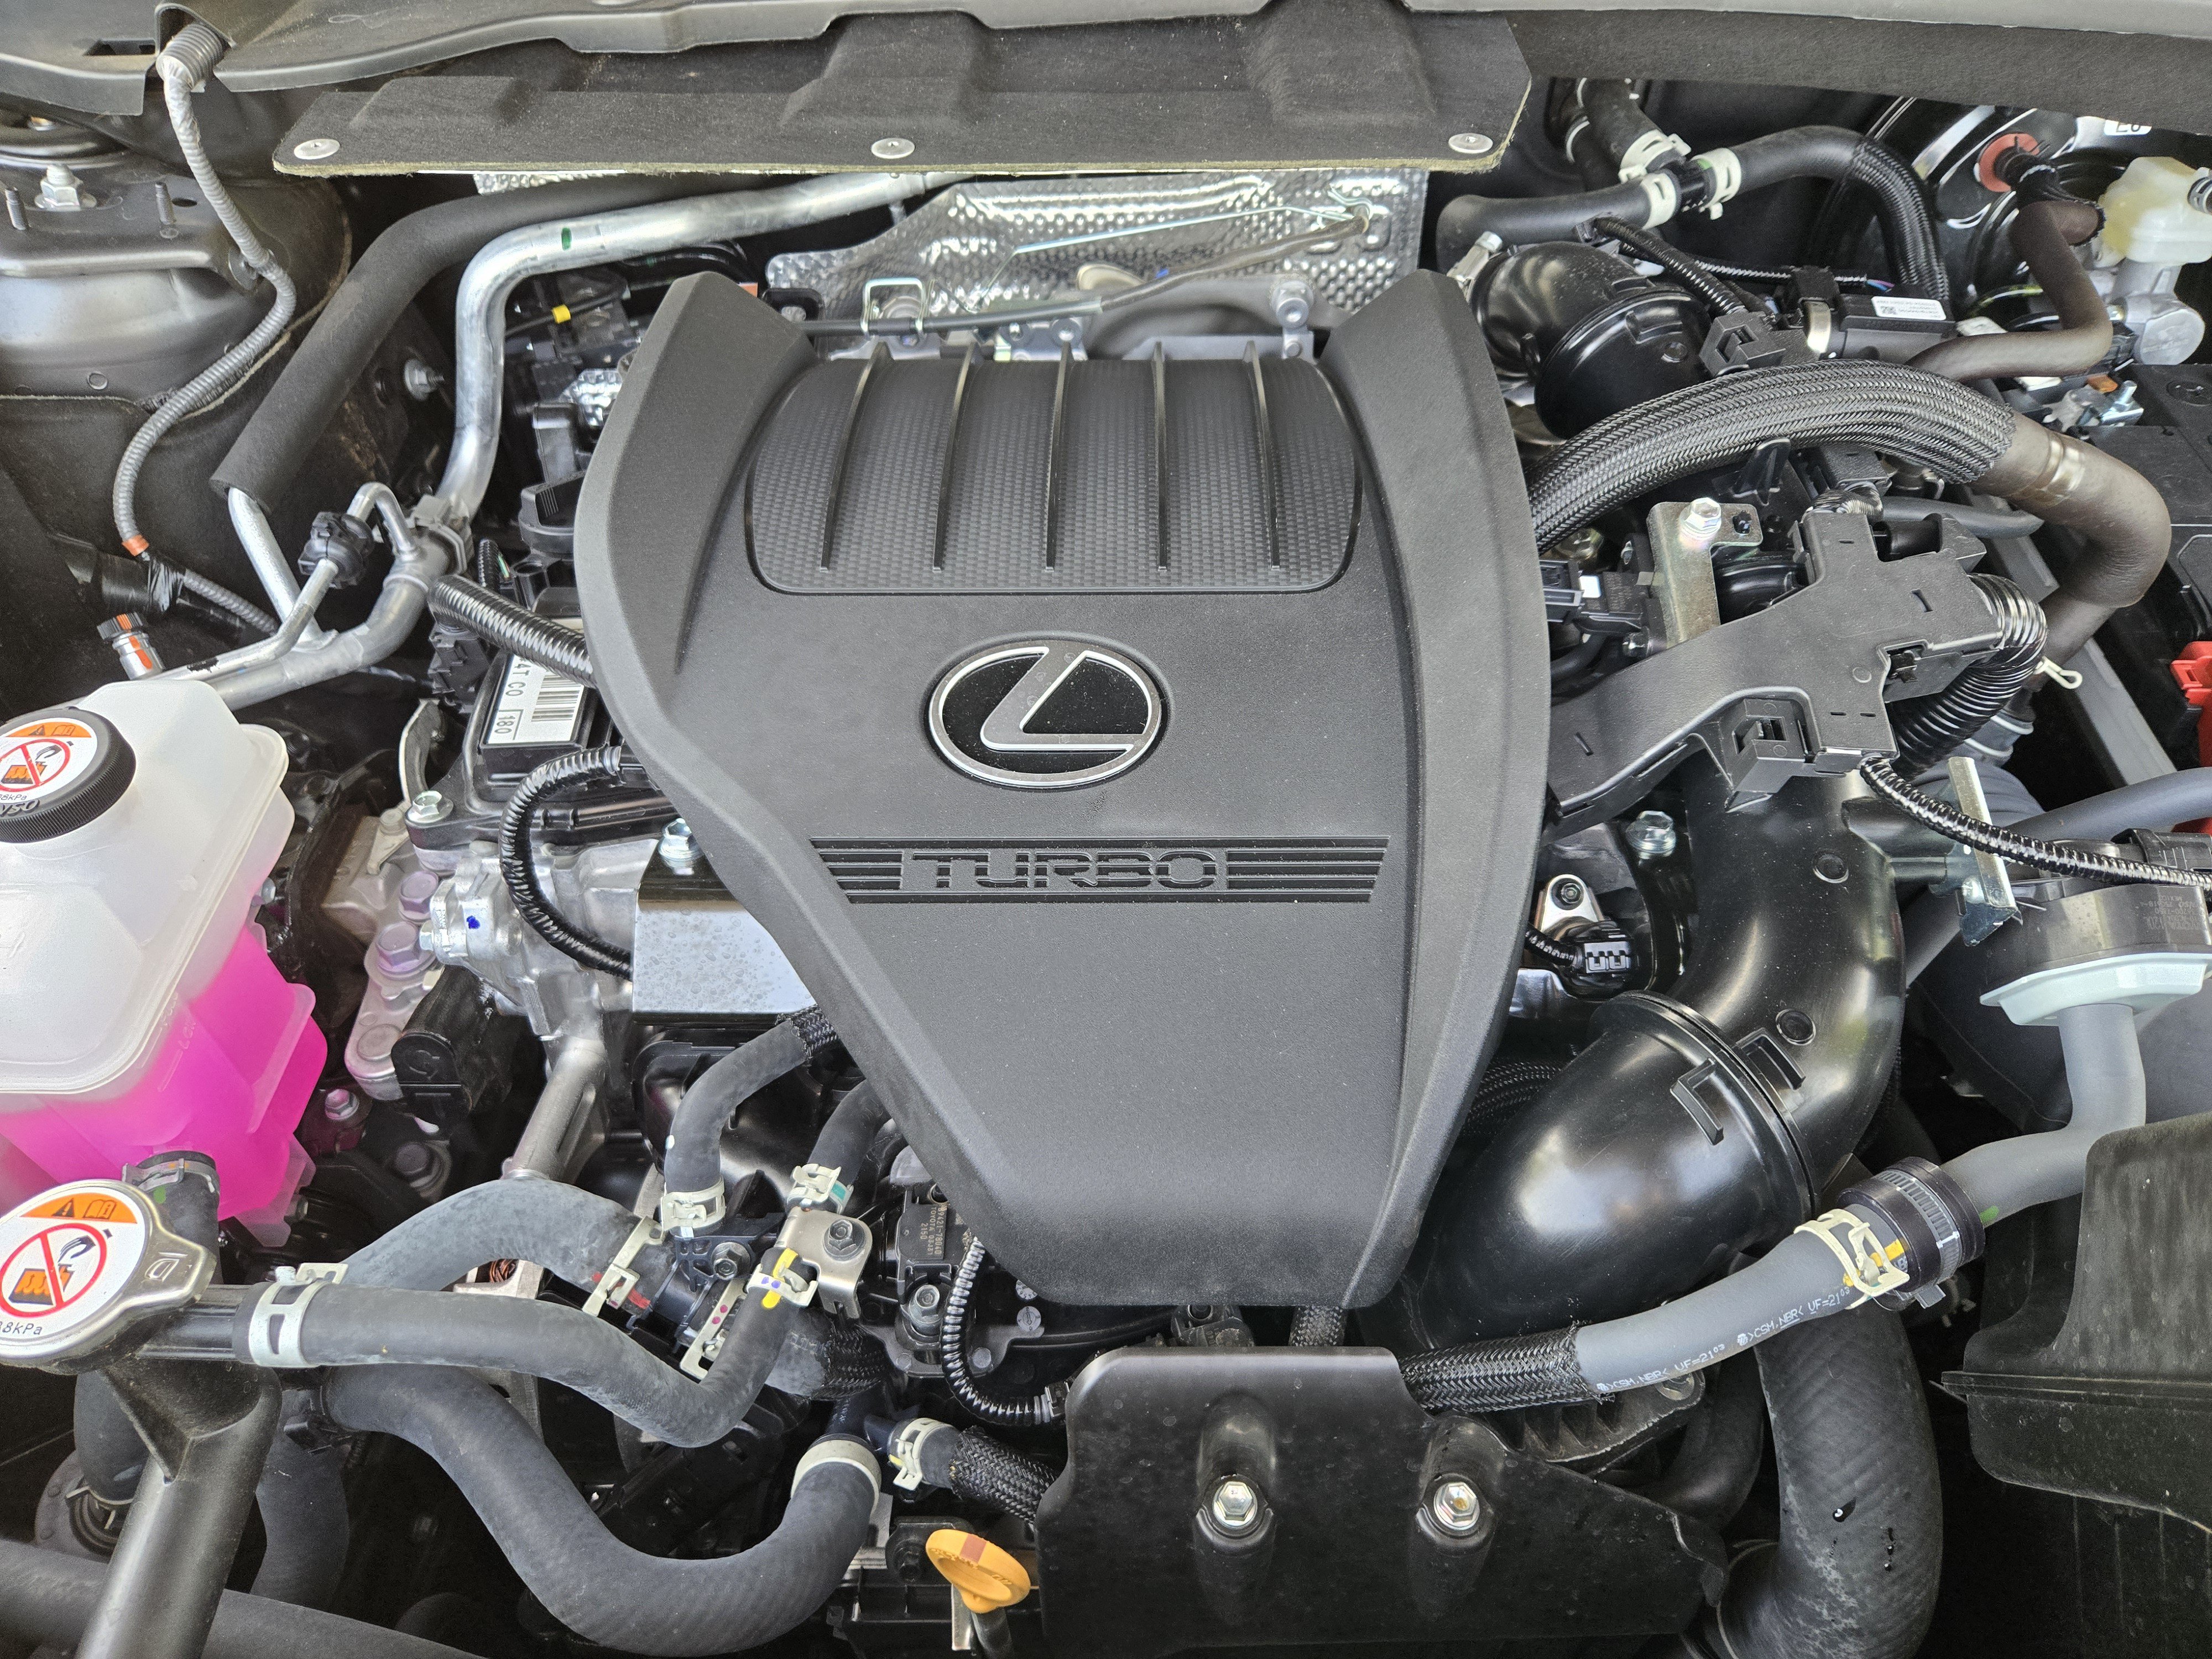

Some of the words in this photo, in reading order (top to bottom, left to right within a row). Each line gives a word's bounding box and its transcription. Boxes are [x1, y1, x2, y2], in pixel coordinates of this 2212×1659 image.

[494, 715, 516, 734] 180
[912, 850, 1218, 889] TURBO
[920, 1222, 929, 1240] 2150
